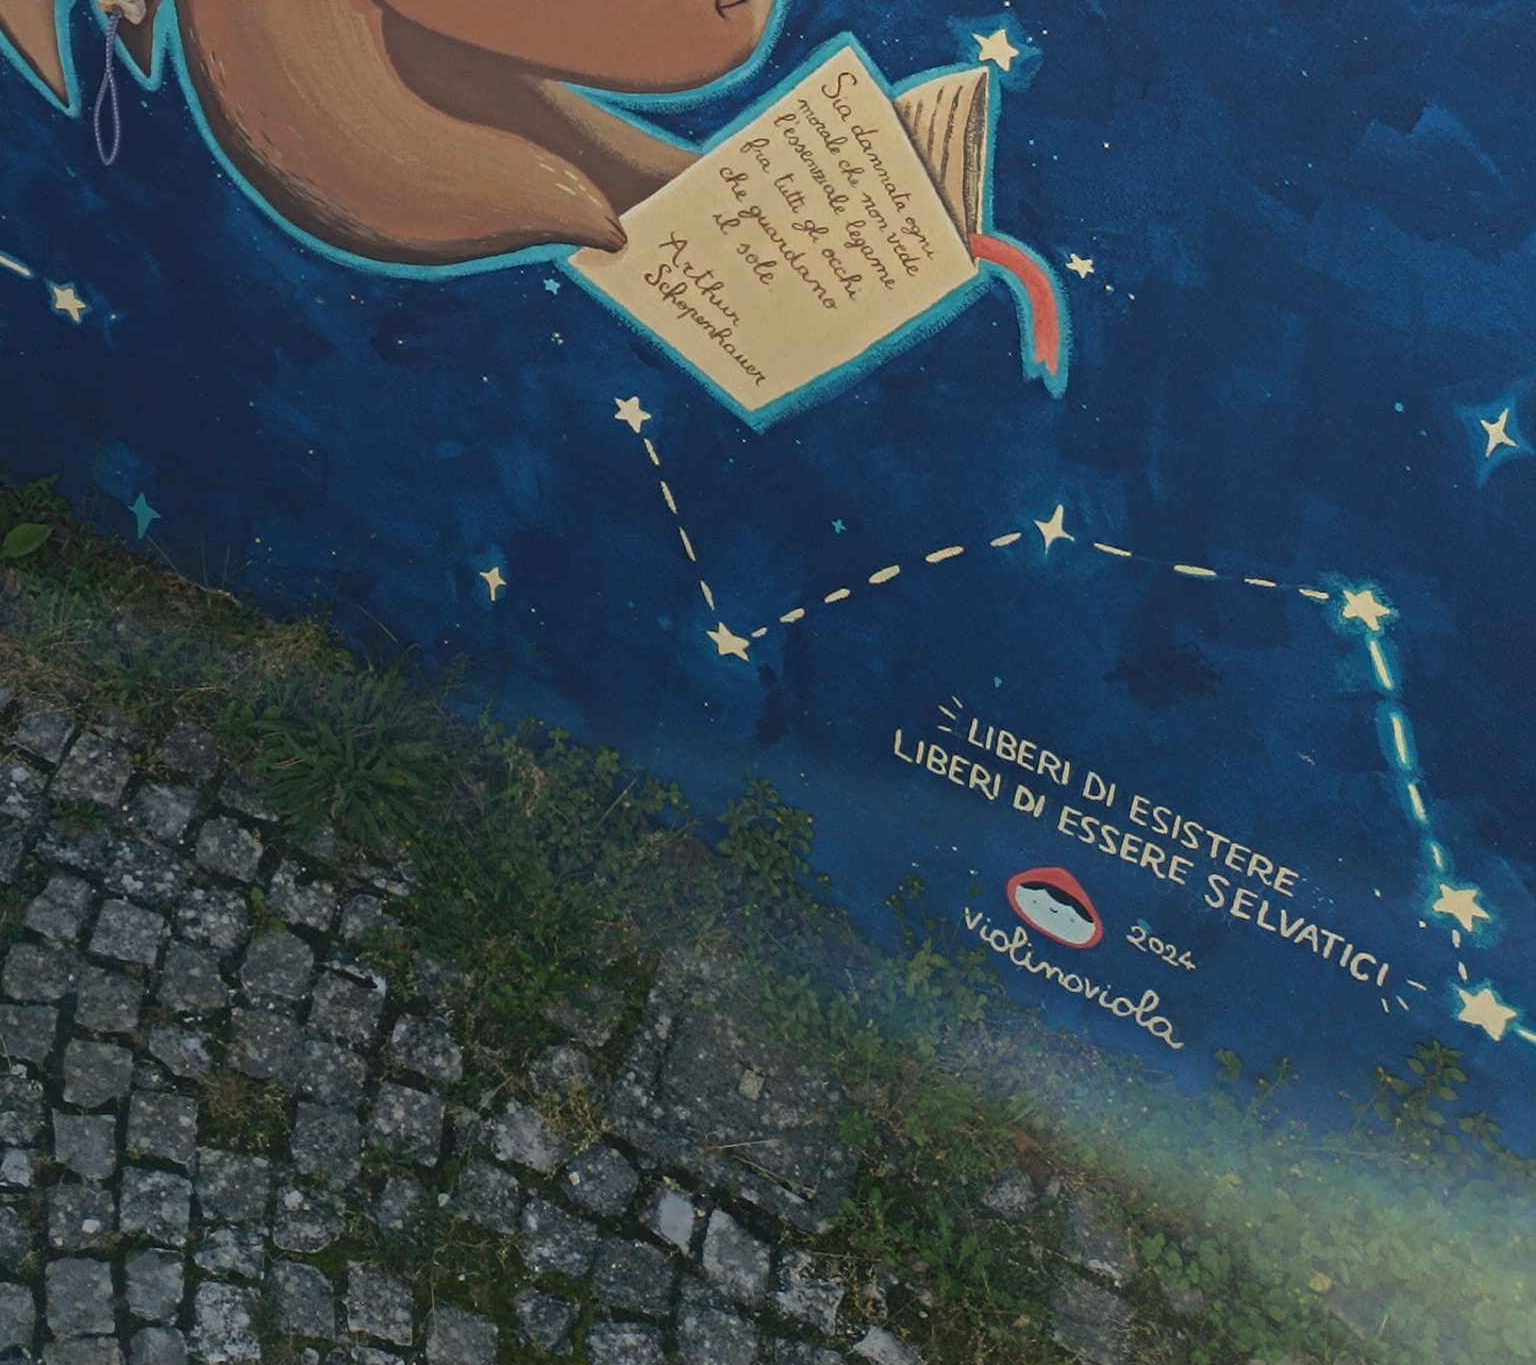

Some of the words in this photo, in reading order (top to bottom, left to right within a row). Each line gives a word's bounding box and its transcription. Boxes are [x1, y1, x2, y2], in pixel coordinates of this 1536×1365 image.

[719, 166, 749, 204] che
[737, 205, 838, 311] guardano
[739, 137, 771, 174] fra
[773, 172, 806, 215] tutti
[791, 219, 830, 244] gli
[821, 247, 864, 302] occhi
[798, 98, 849, 156] morale
[838, 159, 864, 189] che
[862, 191, 888, 233] non
[887, 231, 919, 278] vede
[821, 71, 858, 123] Sia
[850, 124, 912, 213] dannata
[900, 215, 935, 261] ogni
[658, 231, 741, 329] Arthur
[712, 210, 742, 236] il
[736, 242, 778, 287] sole
[845, 219, 897, 291] legame
[644, 262, 767, 387] Schopenhauer
[893, 728, 1002, 800] LIBERI
[1012, 785, 1047, 818] DI
[1057, 807, 1196, 886] ESSERE
[1204, 874, 1390, 988] SELVATICI
[967, 718, 1072, 786] LIBERI
[1082, 772, 1117, 807] DI
[1129, 794, 1301, 899] ESISTERE
[1126, 925, 1198, 973] 2024
